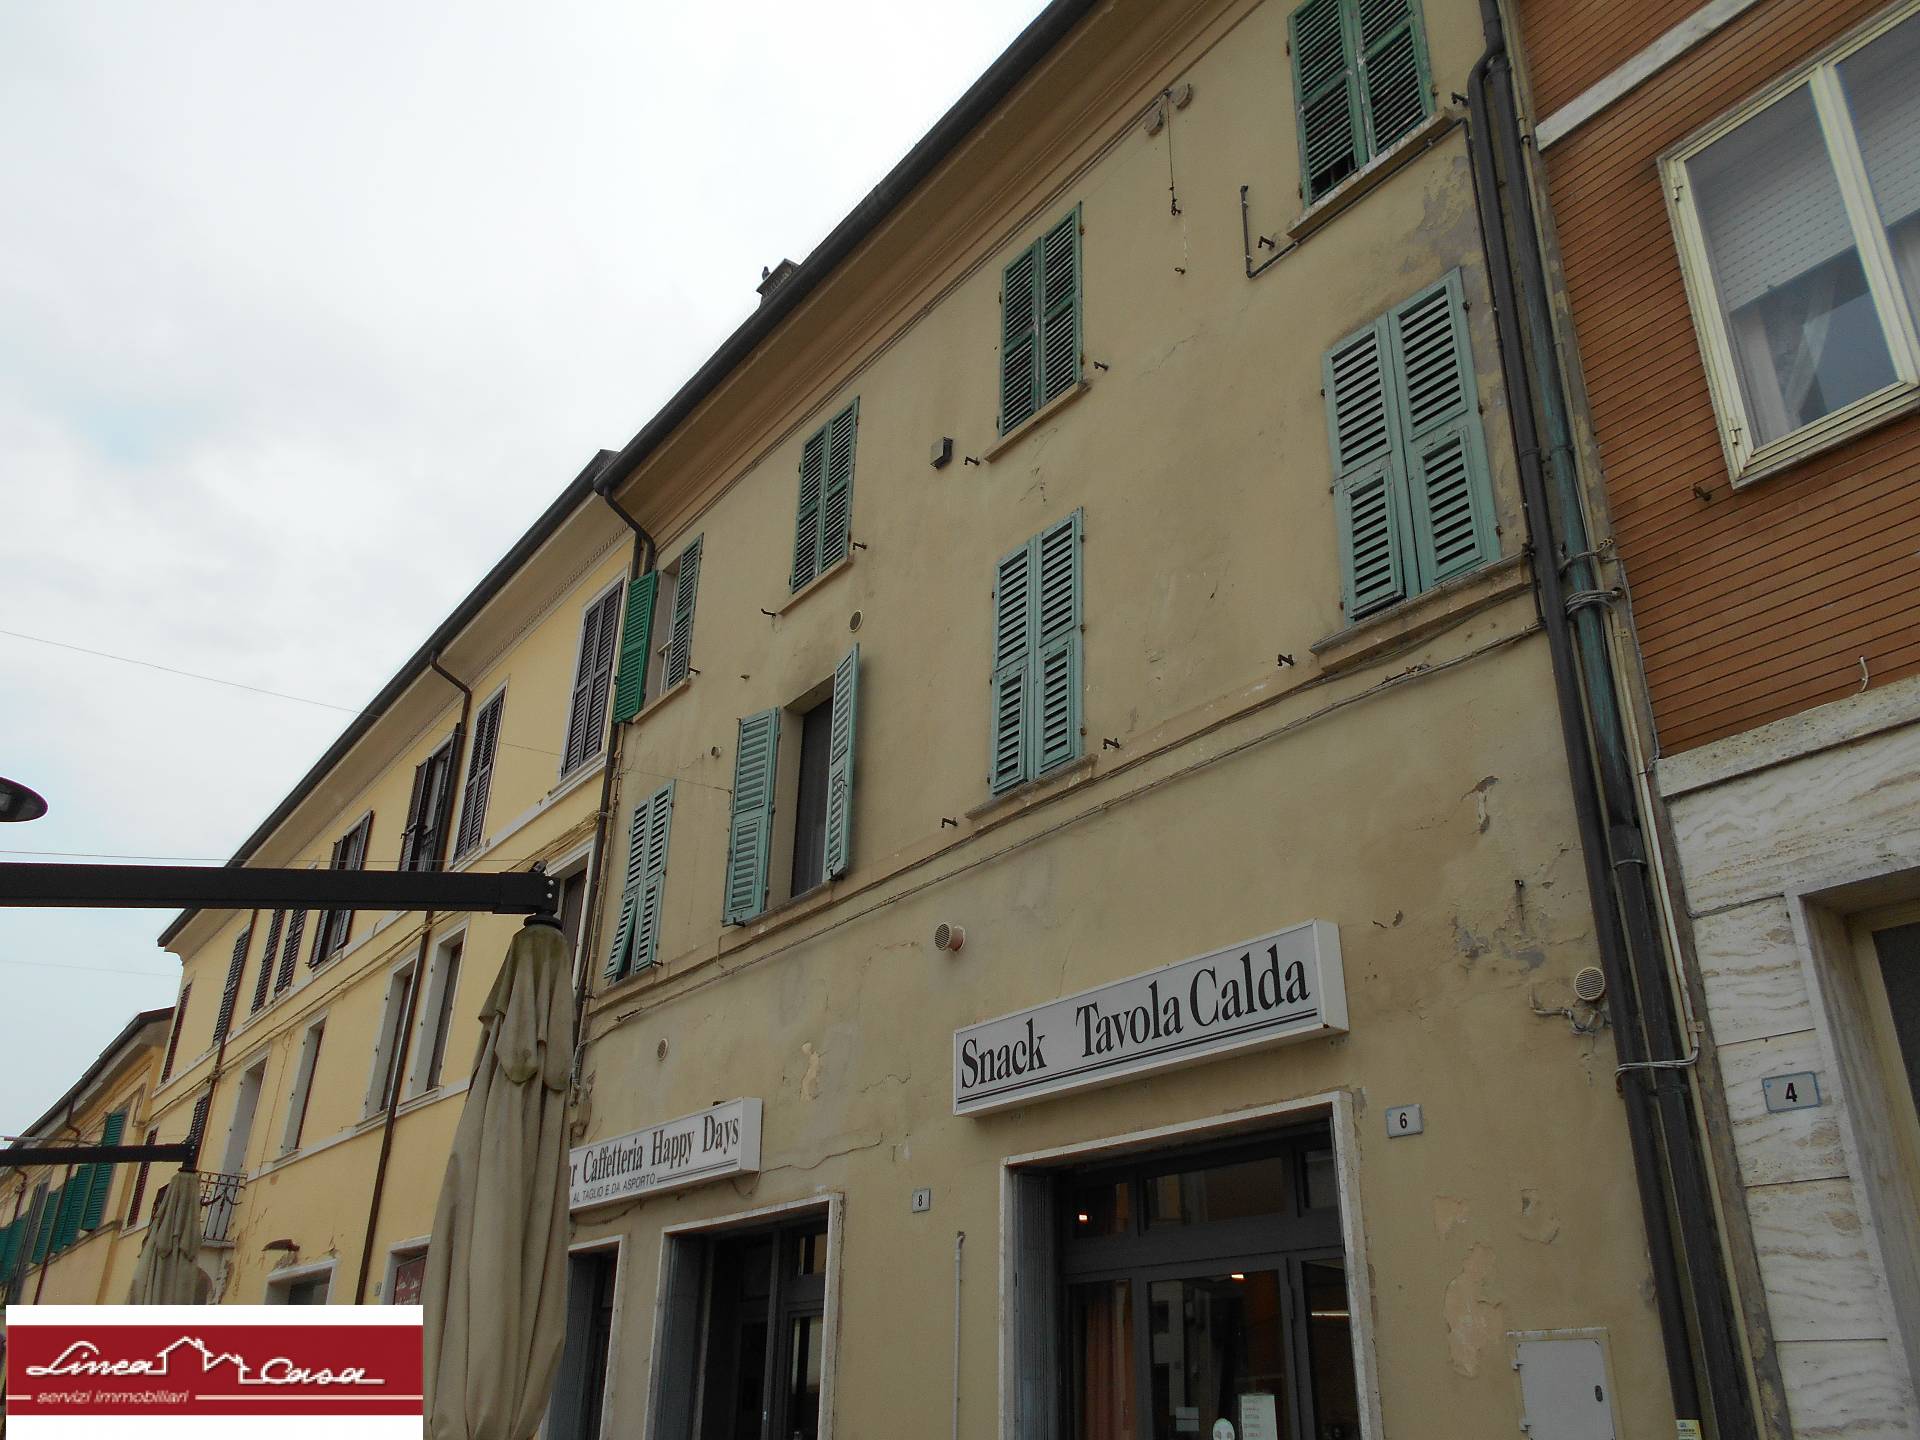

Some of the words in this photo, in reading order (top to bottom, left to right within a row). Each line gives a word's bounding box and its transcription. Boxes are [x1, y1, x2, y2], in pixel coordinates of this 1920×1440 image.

[961, 1018, 1048, 1089] Snack
[1076, 980, 1184, 1059] Tavola
[1189, 943, 1311, 1027] Calda
[1785, 1082, 1798, 1103] 4
[1399, 1112, 1408, 1129] 6
[569, 1163, 578, 1188] r
[583, 1138, 643, 1184] Caffetteria
[650, 1129, 695, 1170] Happy
[702, 1115, 739, 1155] Days
[583, 1186, 604, 1200] TAGLIO
[605, 1185, 610, 1196] E
[611, 1183, 620, 1194] DA
[623, 1173, 656, 1191] ASPORTO
